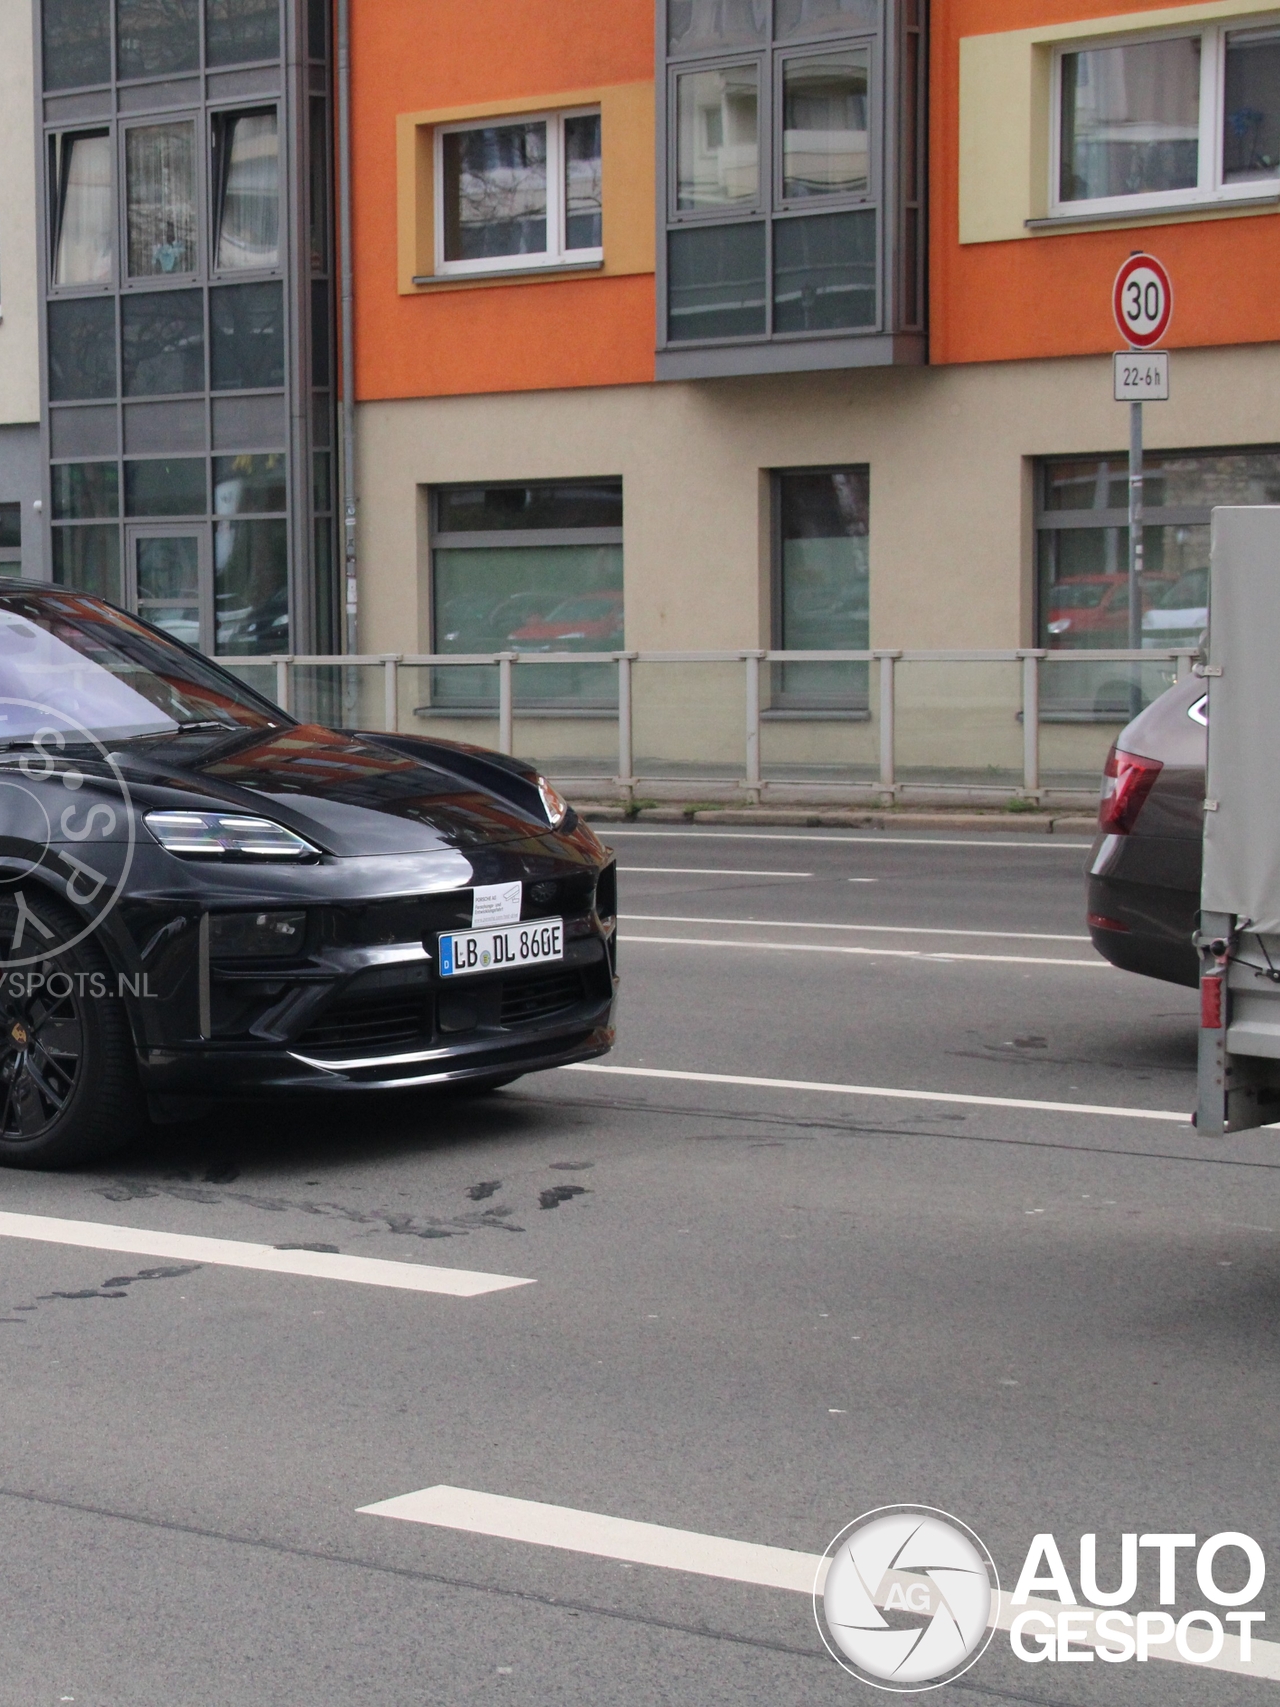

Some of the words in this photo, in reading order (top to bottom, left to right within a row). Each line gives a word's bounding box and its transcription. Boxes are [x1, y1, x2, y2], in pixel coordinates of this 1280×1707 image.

[1127, 281, 1159, 321] 30
[1123, 367, 1152, 386] 22-6
[1154, 367, 1161, 386] h
[443, 960, 450, 970] D
[454, 938, 478, 969] LB
[493, 933, 515, 963] DL
[520, 926, 561, 959] 860E
